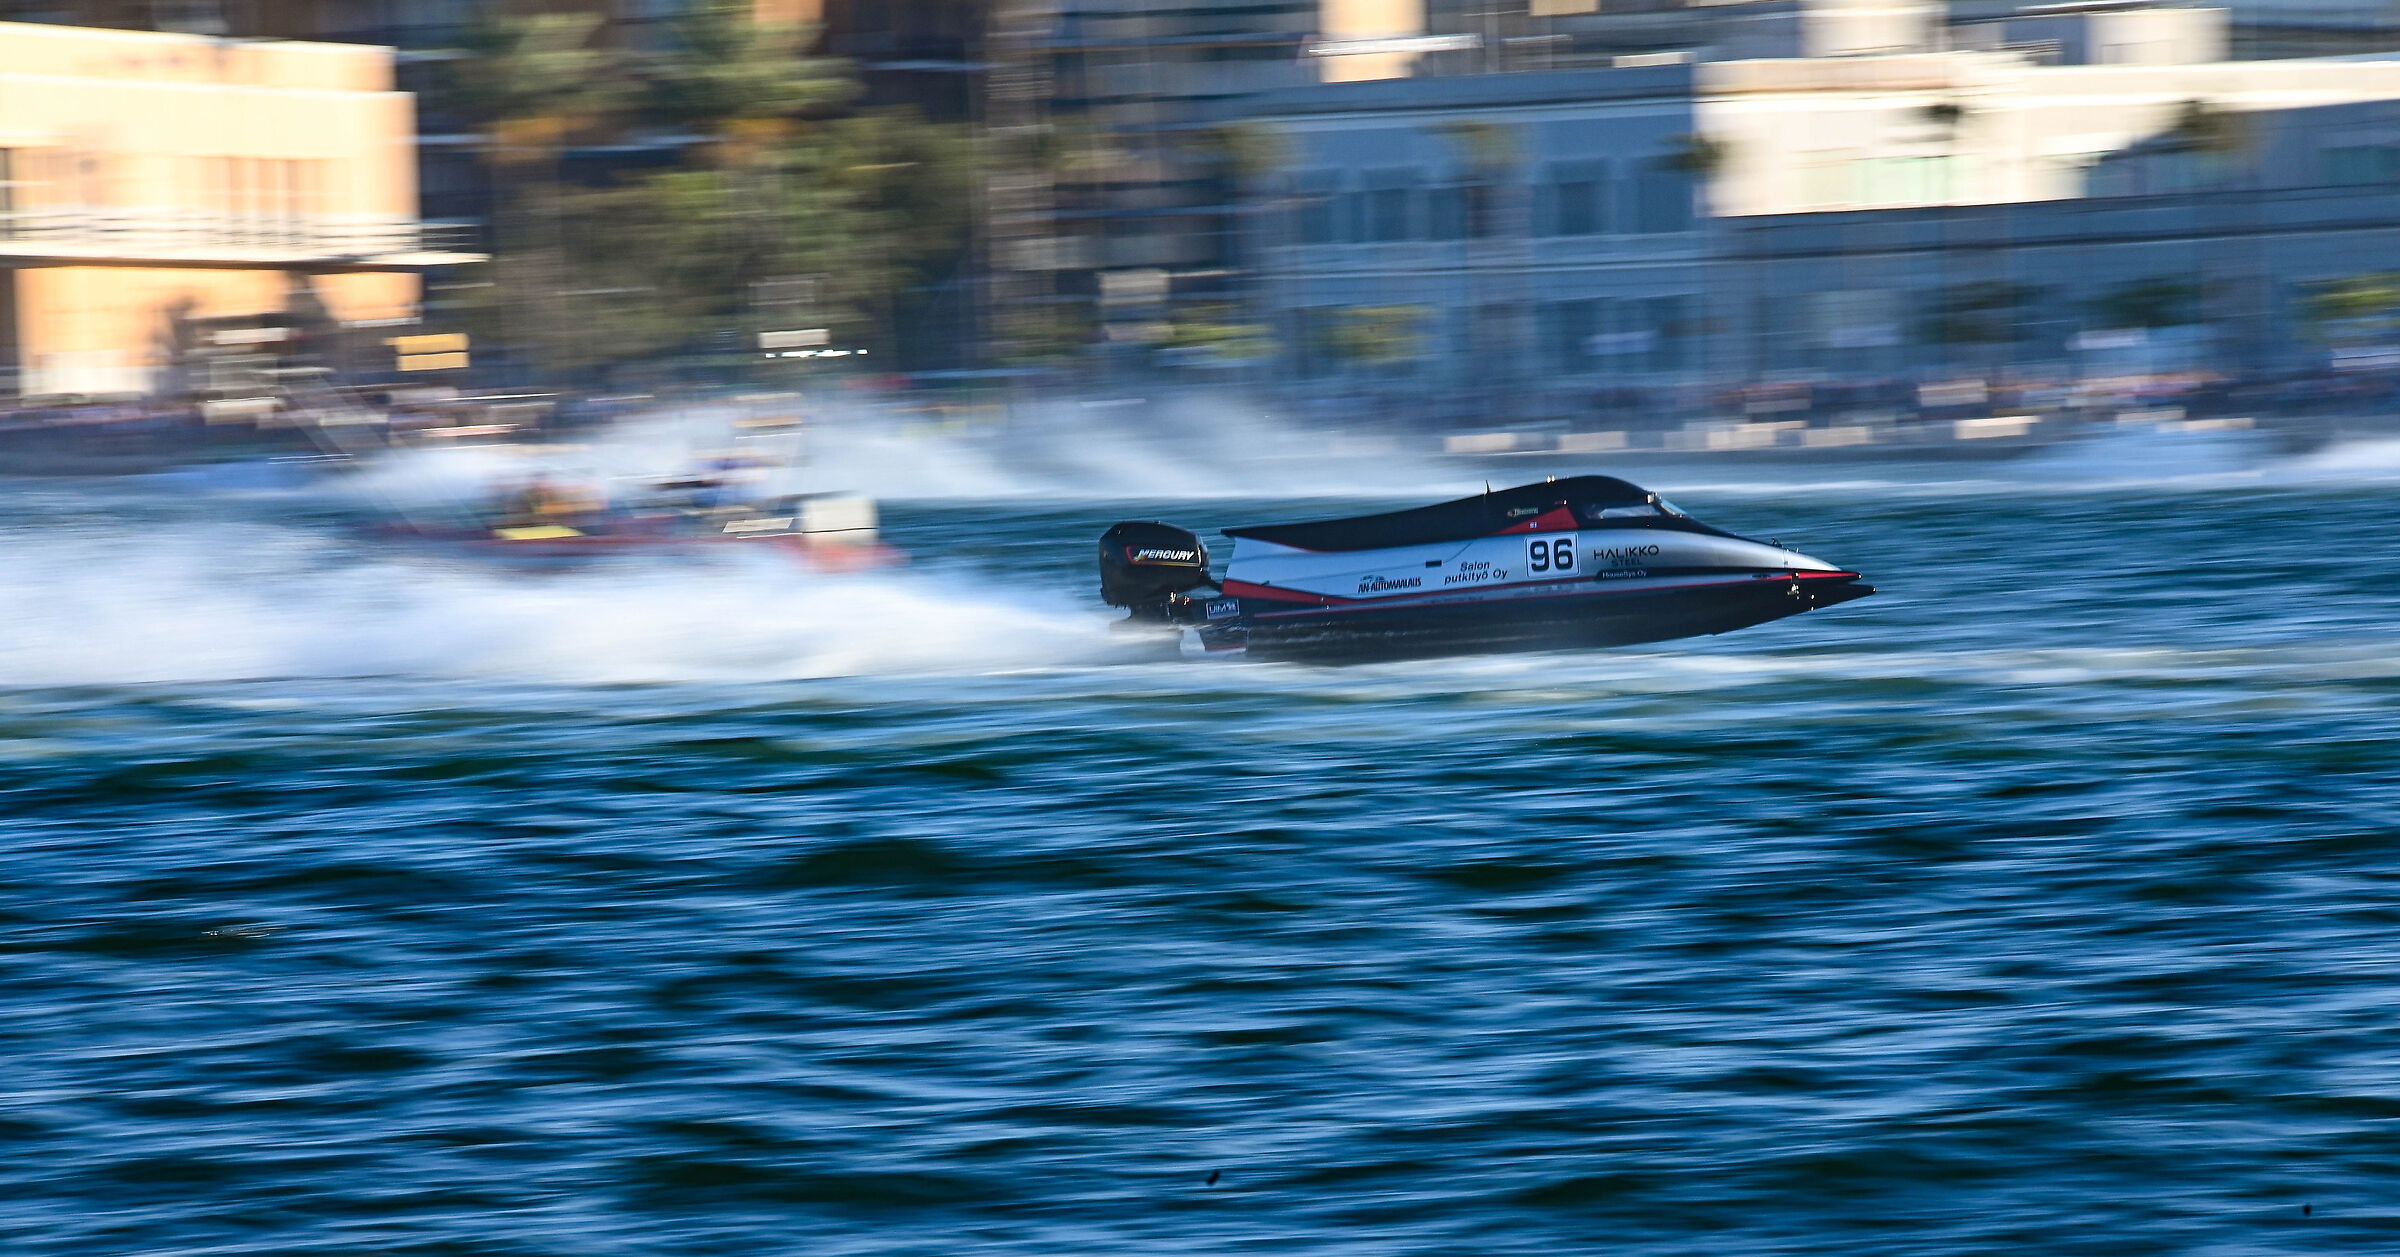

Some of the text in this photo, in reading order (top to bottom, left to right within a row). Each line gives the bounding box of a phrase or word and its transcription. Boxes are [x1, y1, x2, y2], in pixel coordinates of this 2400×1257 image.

[1137, 549, 1194, 561] MERCURY
[1530, 538, 1574, 572] 96
[1593, 545, 1659, 560] HALIKKO
[1460, 561, 1490, 571] Salon
[1444, 568, 1508, 586] putkityö Oy
